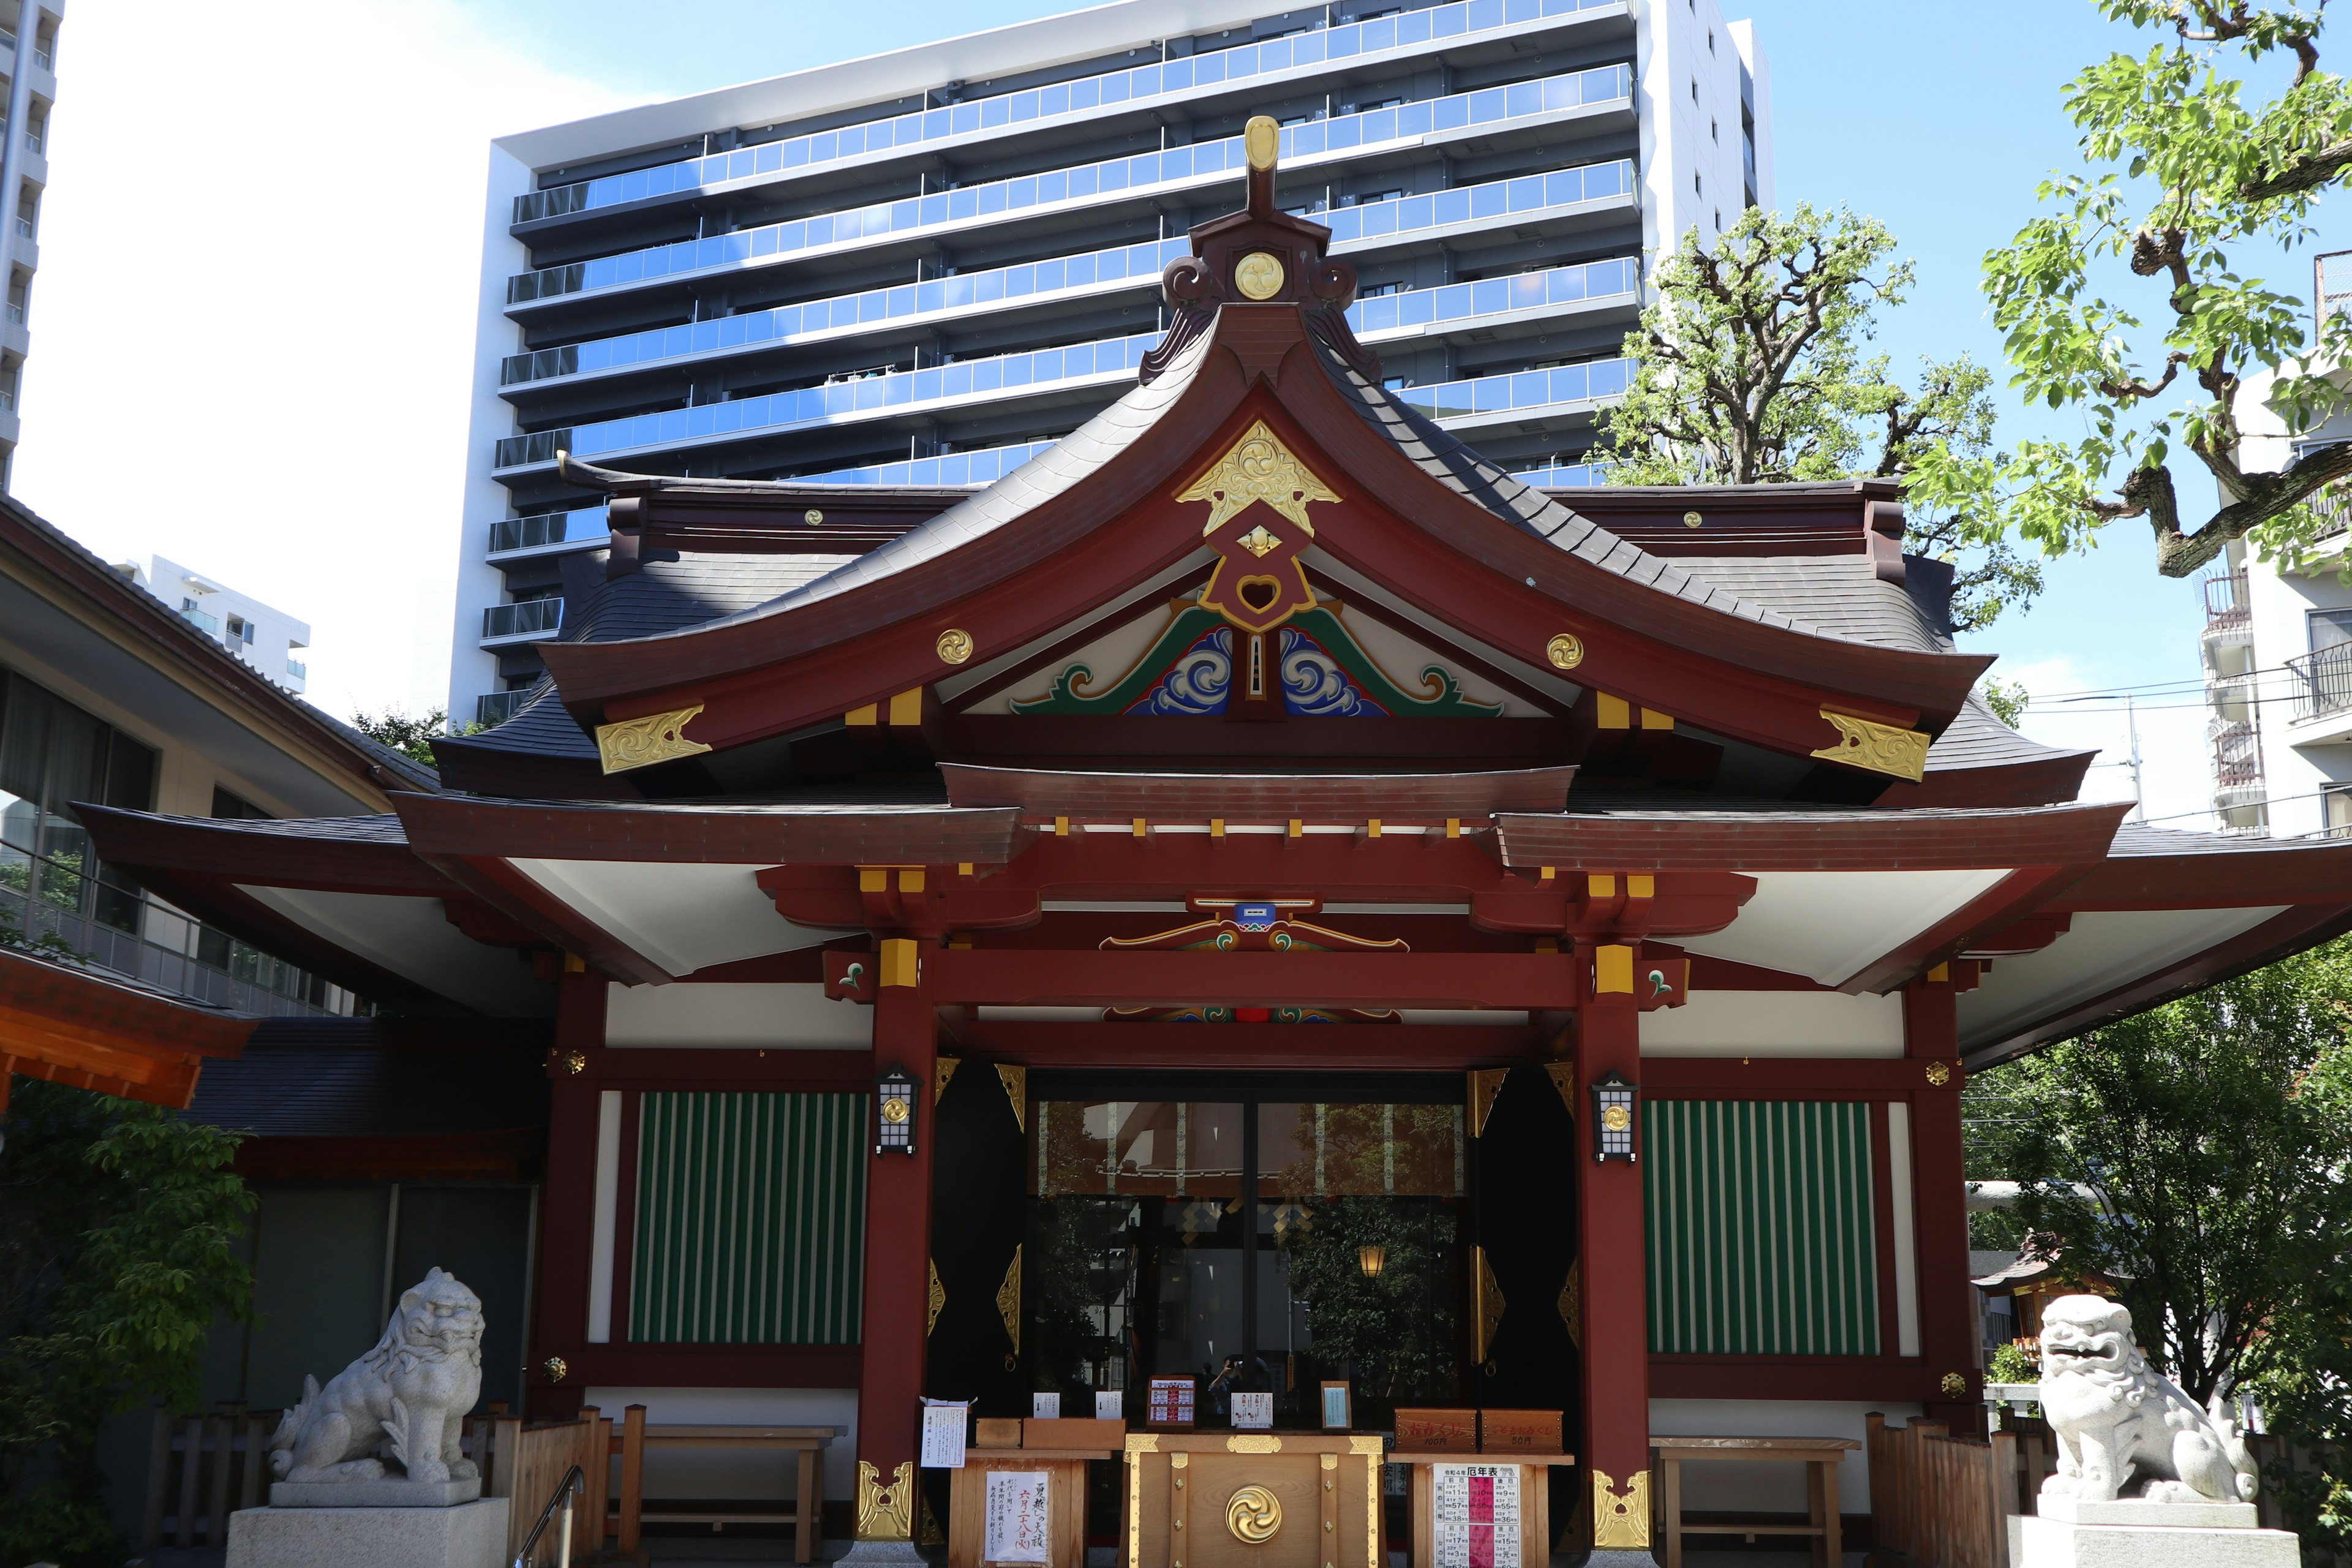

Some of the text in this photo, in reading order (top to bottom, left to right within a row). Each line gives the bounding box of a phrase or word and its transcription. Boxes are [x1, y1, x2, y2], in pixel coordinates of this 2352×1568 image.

[1410, 1422, 1461, 1436] おみくじ
[1512, 1437, 1531, 1445] 50円
[1467, 1467, 1498, 1476] 厄年表
[1031, 1483, 1046, 1548] 夏越しの大祓
